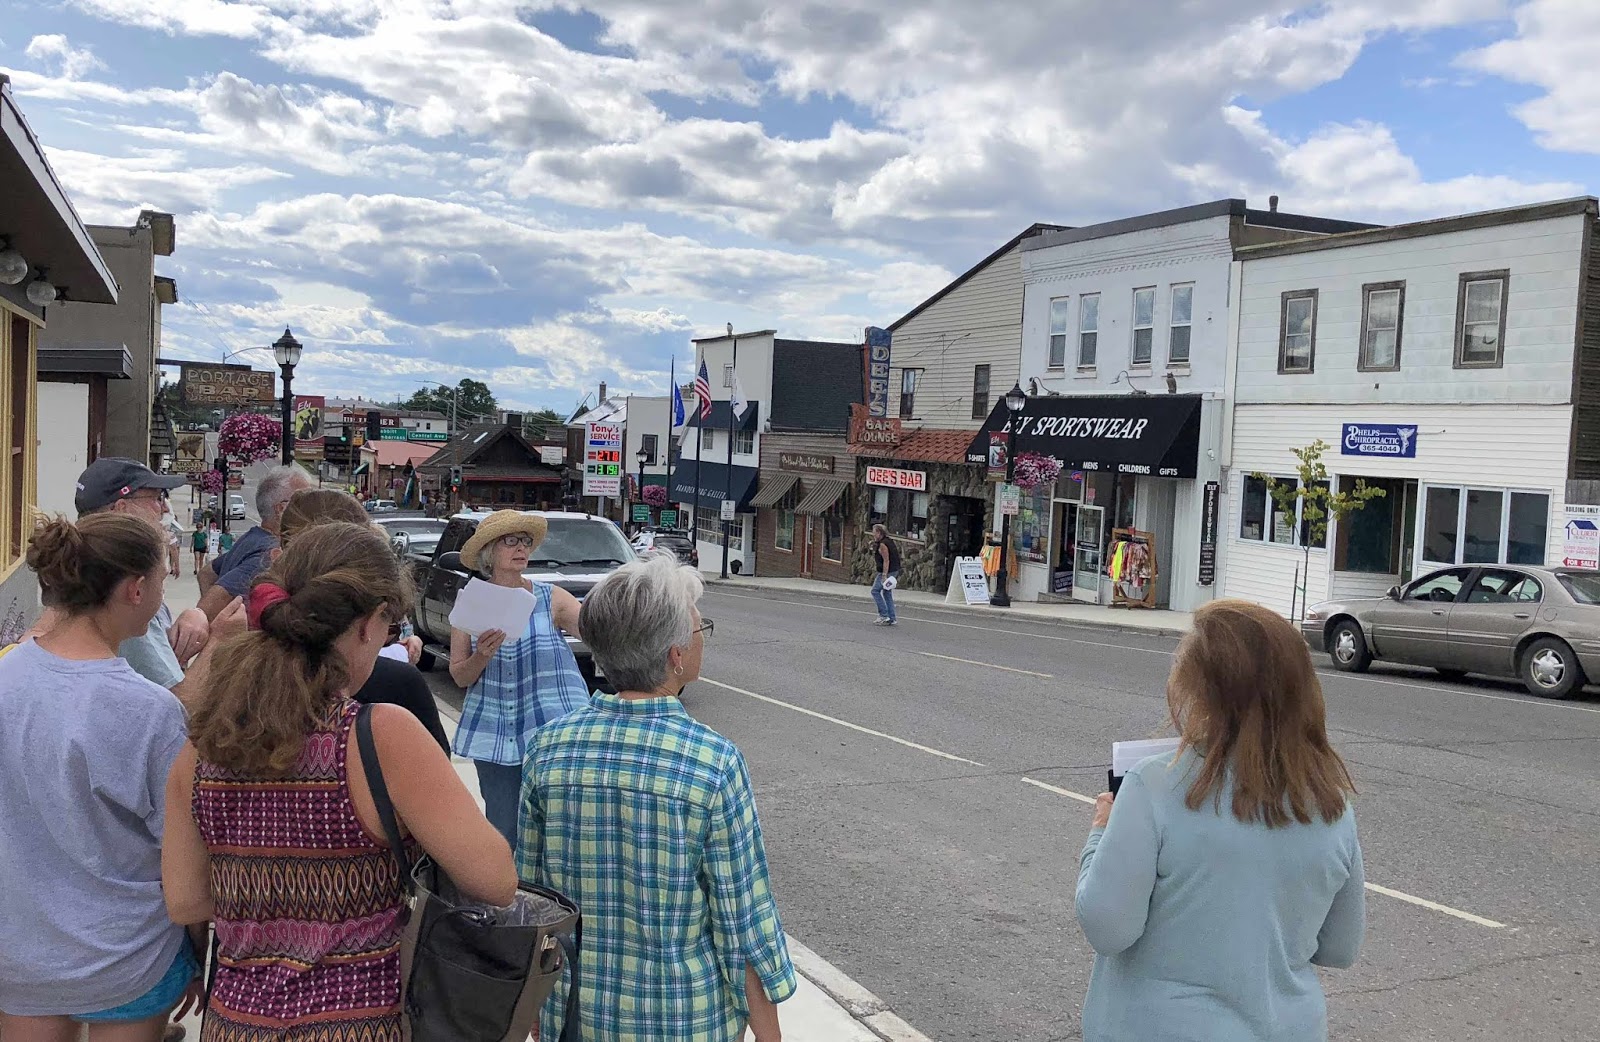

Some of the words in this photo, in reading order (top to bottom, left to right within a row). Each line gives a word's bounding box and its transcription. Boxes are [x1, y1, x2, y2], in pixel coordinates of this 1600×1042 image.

[186, 369, 270, 387] PORTAGE
[199, 384, 260, 397] BAR
[297, 400, 311, 411] Ely
[590, 423, 619, 438] Tony's
[865, 419, 895, 431] BAR
[1031, 416, 1149, 440] SPORTSWEAR
[1348, 425, 1380, 440] PHELPS
[858, 432, 899, 443] LOUNGE
[1345, 433, 1400, 449] CHIROPRACTIC
[968, 454, 986, 462] T-SHIRTS
[1082, 461, 1098, 470] MENS
[1118, 463, 1151, 474] CHILDRENS
[1159, 466, 1178, 476] GIFTS
[869, 468, 897, 485] DEE'S
[899, 471, 922, 488] BAR
